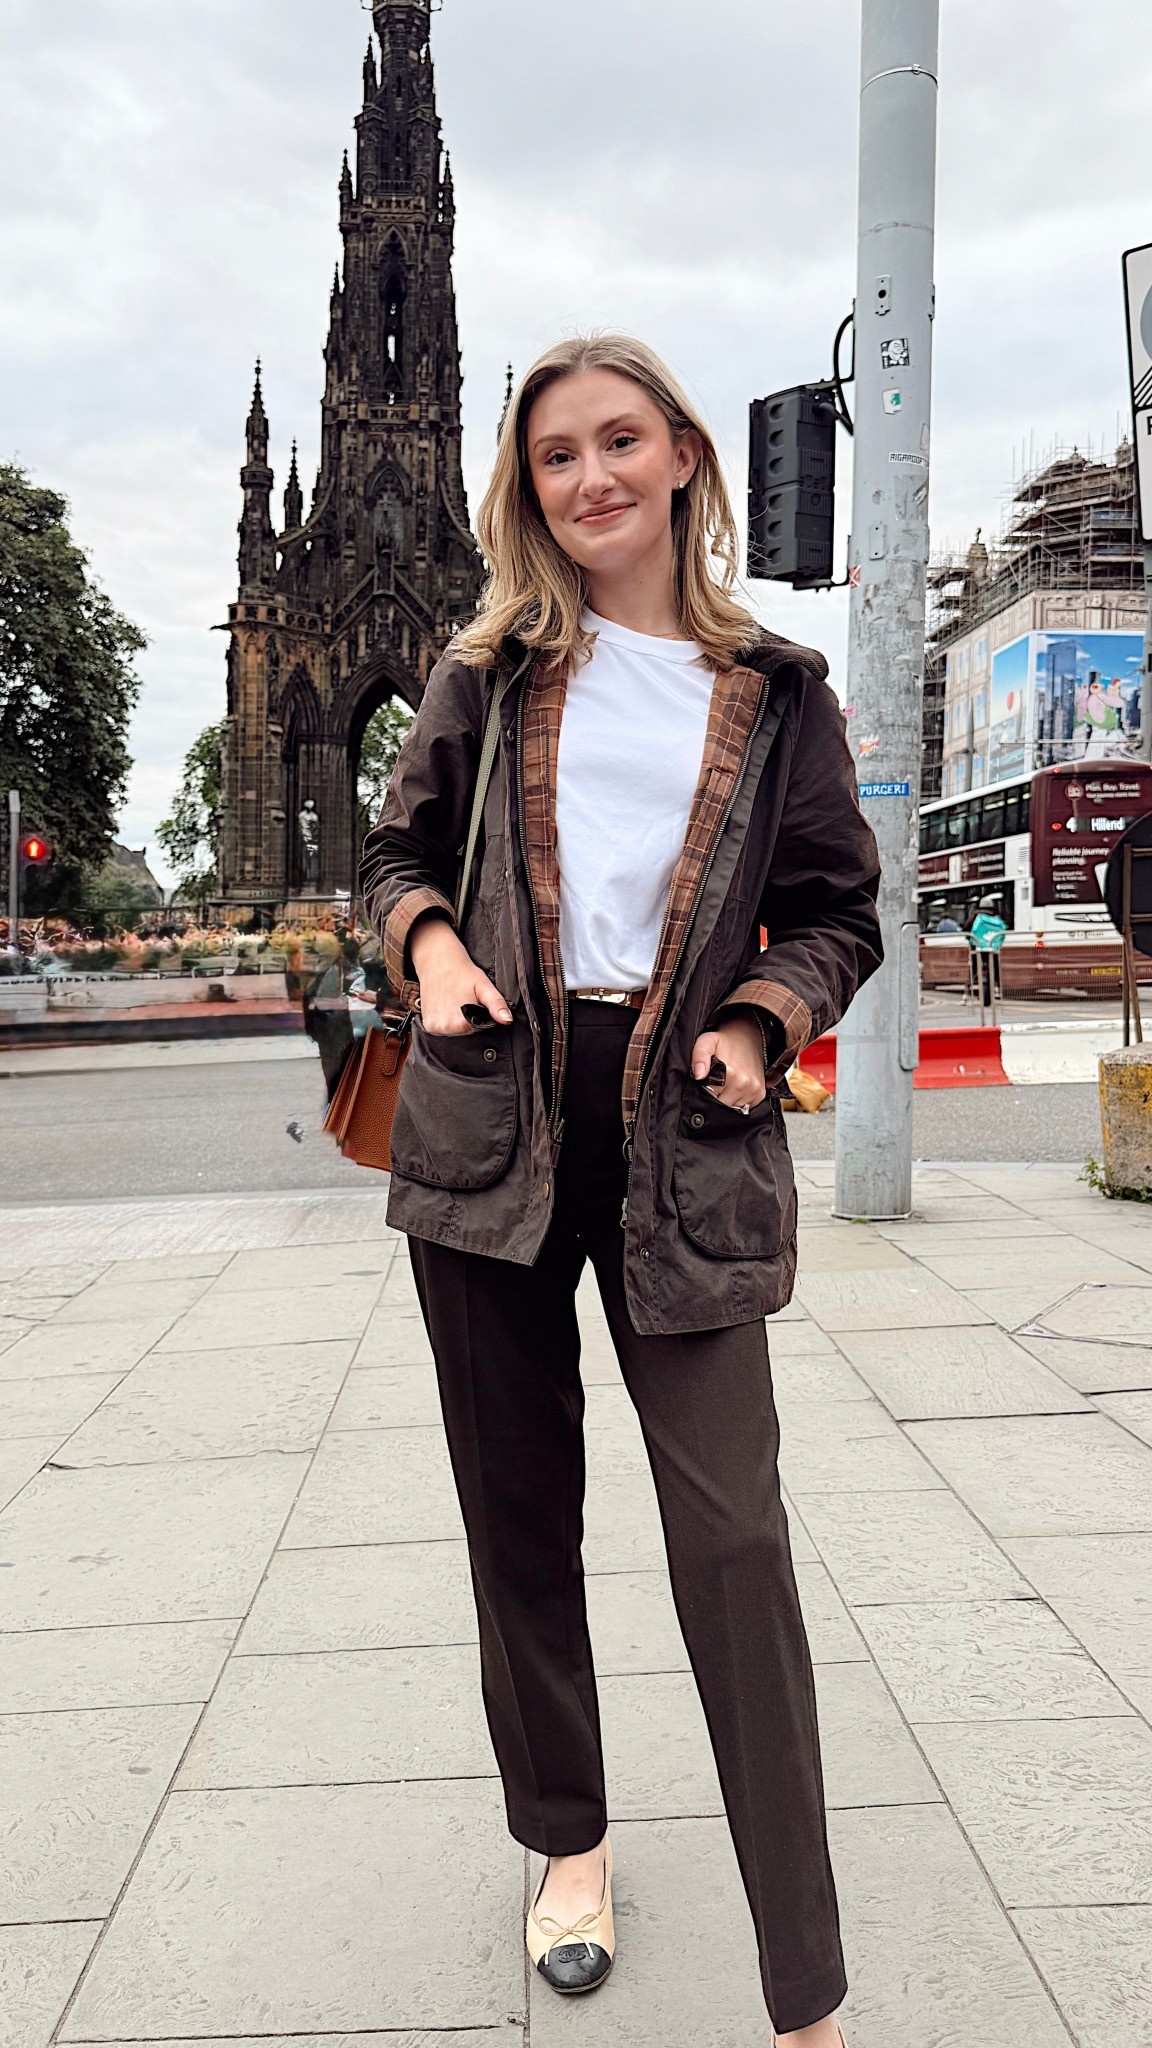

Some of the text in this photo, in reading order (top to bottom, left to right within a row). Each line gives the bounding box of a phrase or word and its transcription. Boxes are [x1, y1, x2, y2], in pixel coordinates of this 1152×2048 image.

[1091, 817, 1126, 832] Hillend
[1052, 847, 1109, 857] Reliable journey
